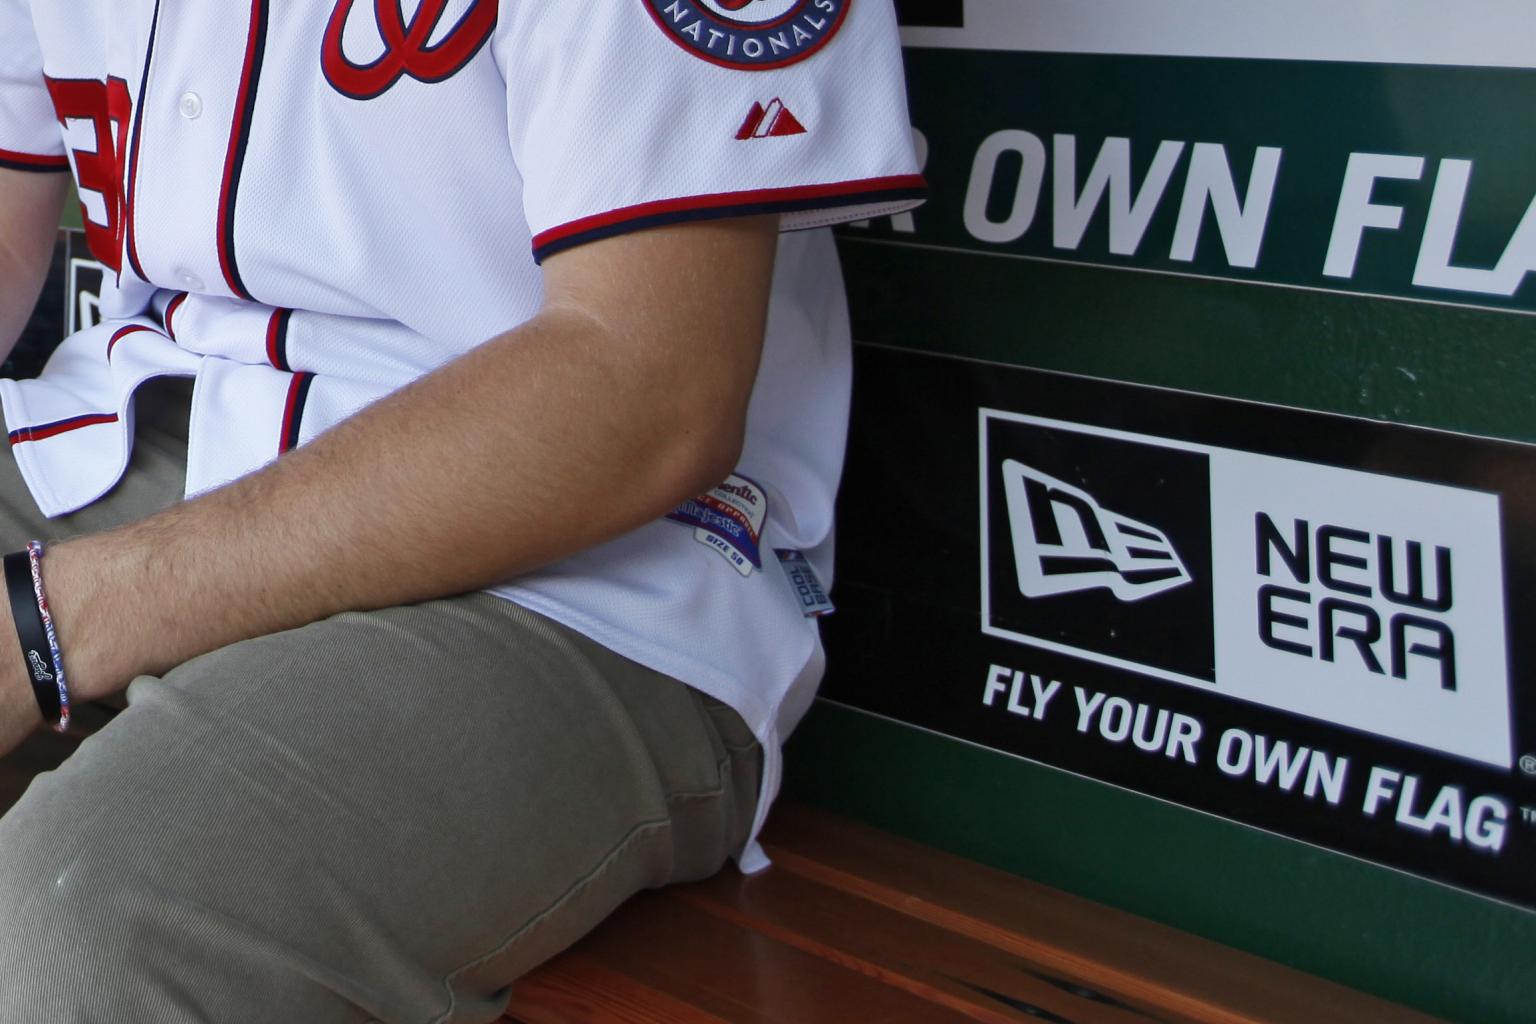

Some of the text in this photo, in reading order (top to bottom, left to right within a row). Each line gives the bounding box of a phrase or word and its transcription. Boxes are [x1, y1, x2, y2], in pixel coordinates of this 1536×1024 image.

[963, 128, 1283, 269] OWN
[705, 534, 730, 553] SIZE
[790, 565, 816, 607] COOL
[1255, 510, 1453, 614] NEW
[1257, 583, 1457, 693] ERA
[982, 663, 1061, 720] FLY
[1074, 686, 1202, 764] YOUR
[1216, 728, 1348, 805] OWN
[1363, 766, 1507, 852] FLAG
